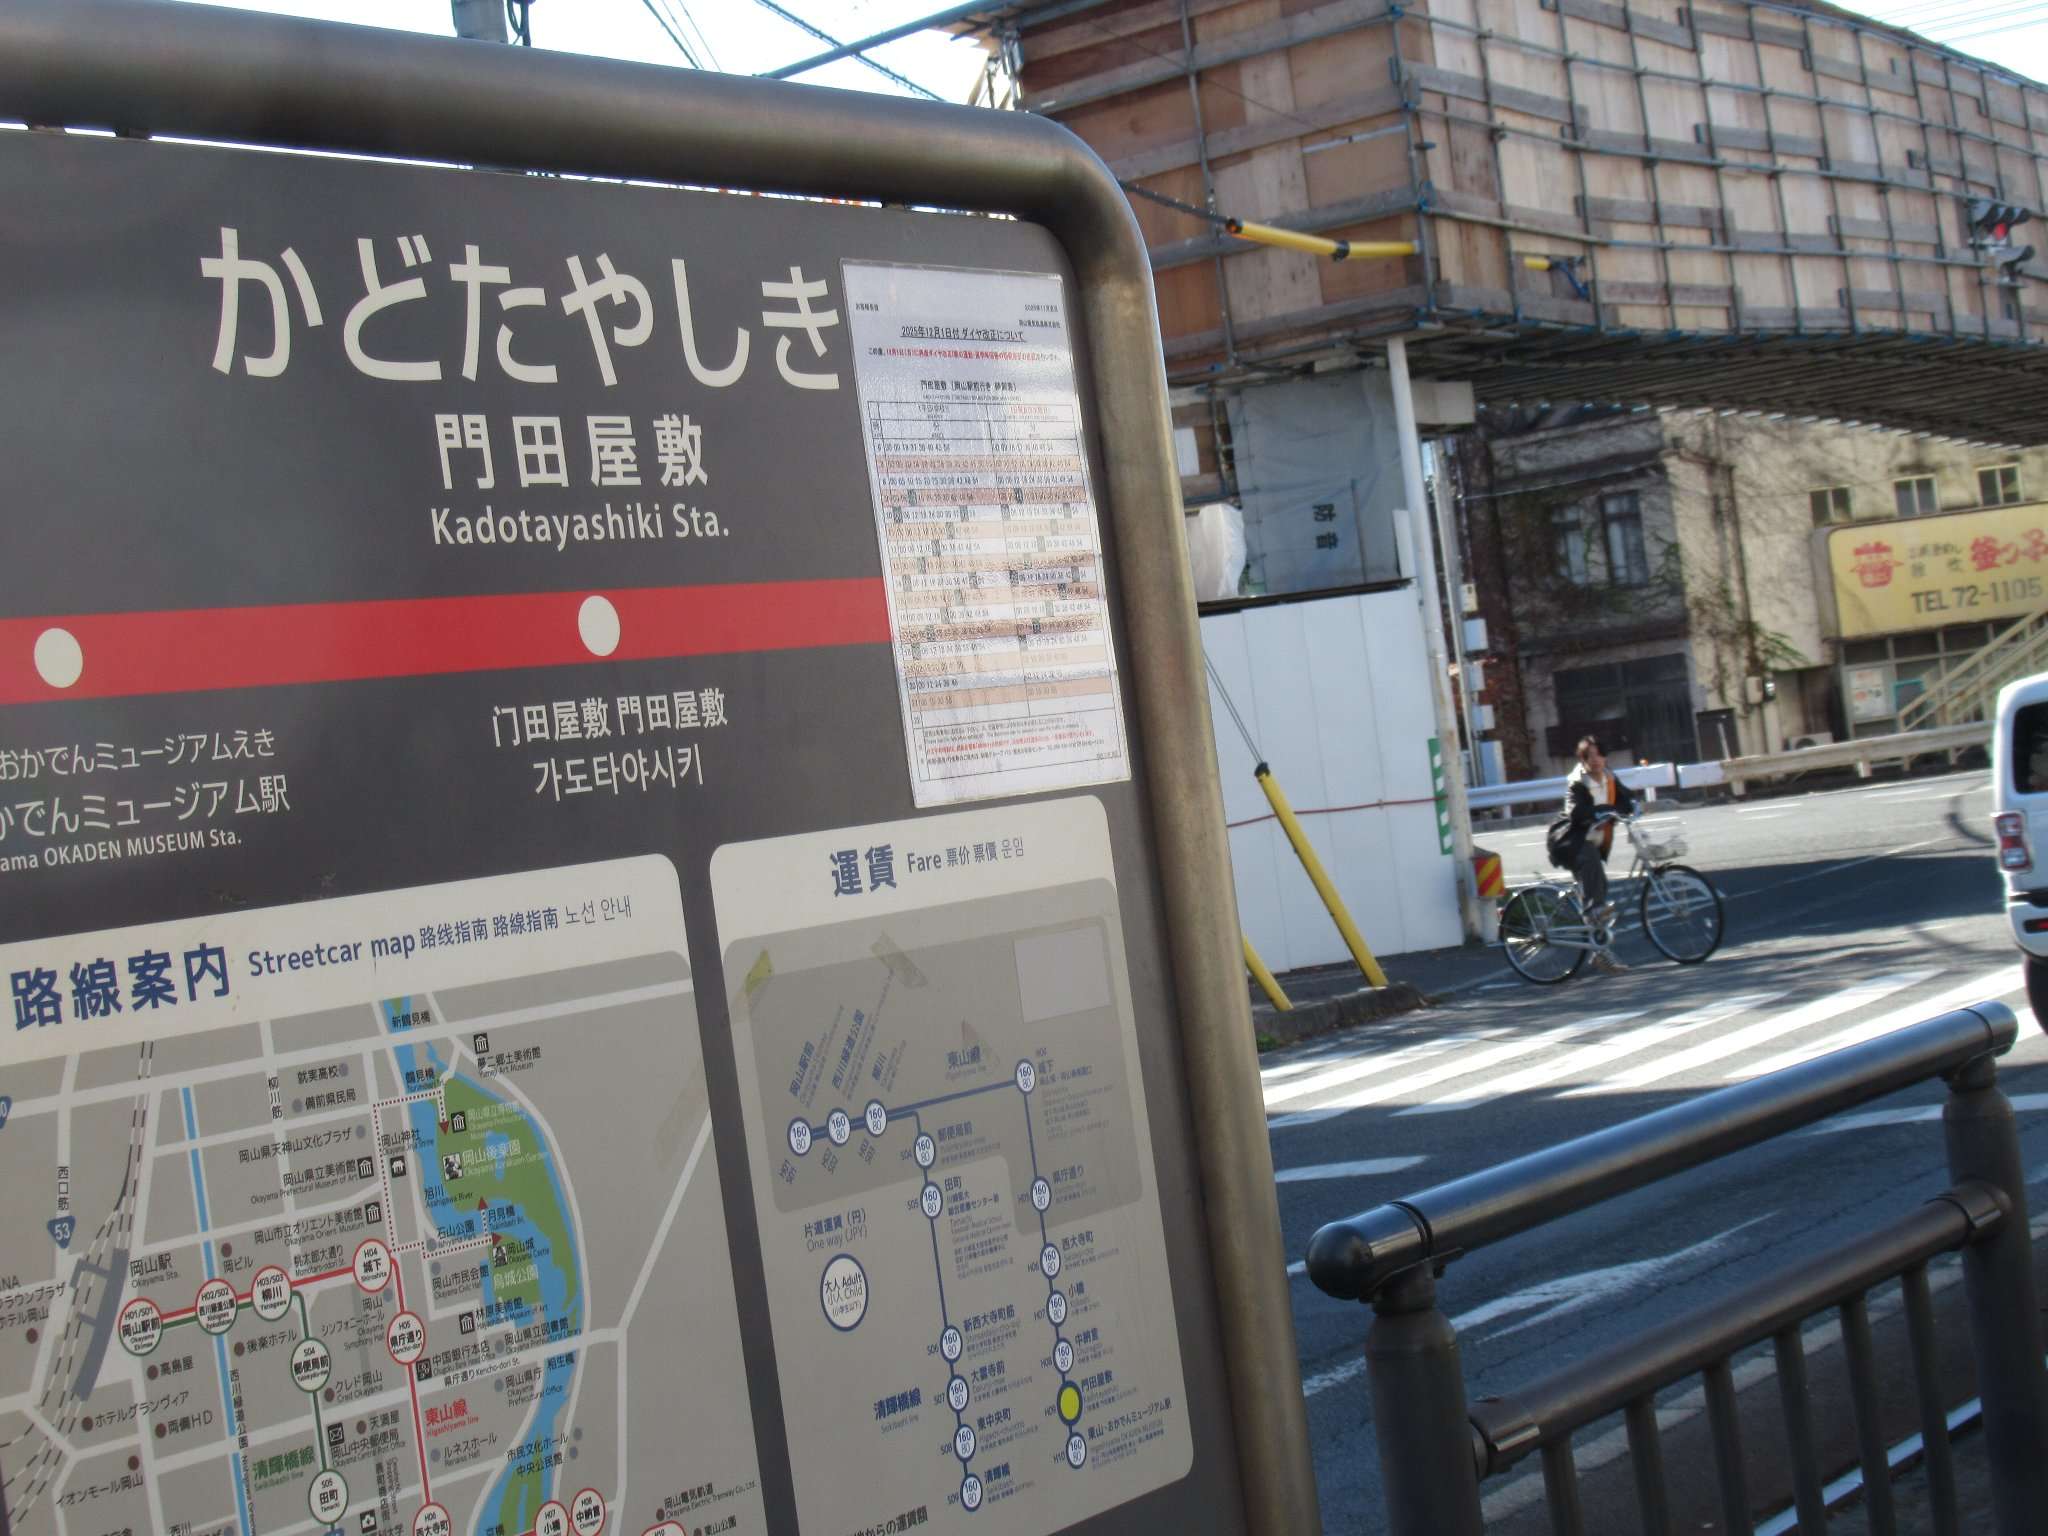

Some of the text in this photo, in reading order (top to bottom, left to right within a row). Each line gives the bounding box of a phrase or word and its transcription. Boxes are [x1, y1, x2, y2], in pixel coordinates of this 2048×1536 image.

[201, 226, 841, 391] かどたやしき
[435, 413, 709, 490] 門田屋敷
[431, 503, 730, 551] Kadotayashiki Sta.
[1911, 590, 1950, 614] TEL
[0, 728, 275, 781] おかでんミュージアムえき
[533, 743, 704, 802] 가도타야시키
[44, 840, 122, 866] OKADEN
[128, 831, 205, 857] MUSEUM
[210, 828, 242, 848] Sta.
[830, 844, 898, 898] 運賃
[907, 852, 942, 873] Fare
[10, 942, 231, 1031] 路線案内
[248, 941, 363, 978] Streetcar
[371, 934, 418, 961] map
[420, 917, 489, 949] 路线指南
[493, 907, 560, 939] 路線指南
[600, 895, 633, 921] 안내
[1019, 1066, 1032, 1078] 160
[869, 1108, 883, 1120] 160
[832, 1116, 846, 1128] 160
[872, 1120, 882, 1132] 80
[793, 1126, 807, 1139] 160
[836, 1128, 846, 1140] 80
[795, 1138, 806, 1151] 80
[917, 1138, 931, 1151] 160
[283, 1159, 358, 1186] 岡山県立美術館
[924, 1190, 938, 1202] 160
[1034, 1184, 1047, 1196] 160
[927, 1201, 937, 1214] 80
[54, 1222, 71, 1240] 53
[806, 1238, 825, 1252] One
[826, 1235, 843, 1249] way
[1044, 1251, 1057, 1262] 160
[130, 1253, 173, 1277] 岡山駅
[224, 1255, 255, 1273] 岡ビル
[842, 1272, 862, 1288] Adult
[1050, 1297, 1063, 1309] 160
[944, 1331, 958, 1344] 160
[947, 1343, 957, 1356] 80
[1057, 1345, 1070, 1357] 160
[951, 1382, 964, 1395] 160
[95, 1390, 190, 1428] ホテルグランヴィア
[425, 1398, 468, 1426] 東山線
[958, 1430, 971, 1443] 160
[961, 1442, 971, 1455] 80
[1070, 1439, 1083, 1452] 160
[56, 1472, 144, 1506] イオンモール岡山
[964, 1479, 978, 1493] 160
[319, 1489, 339, 1505] 田町
